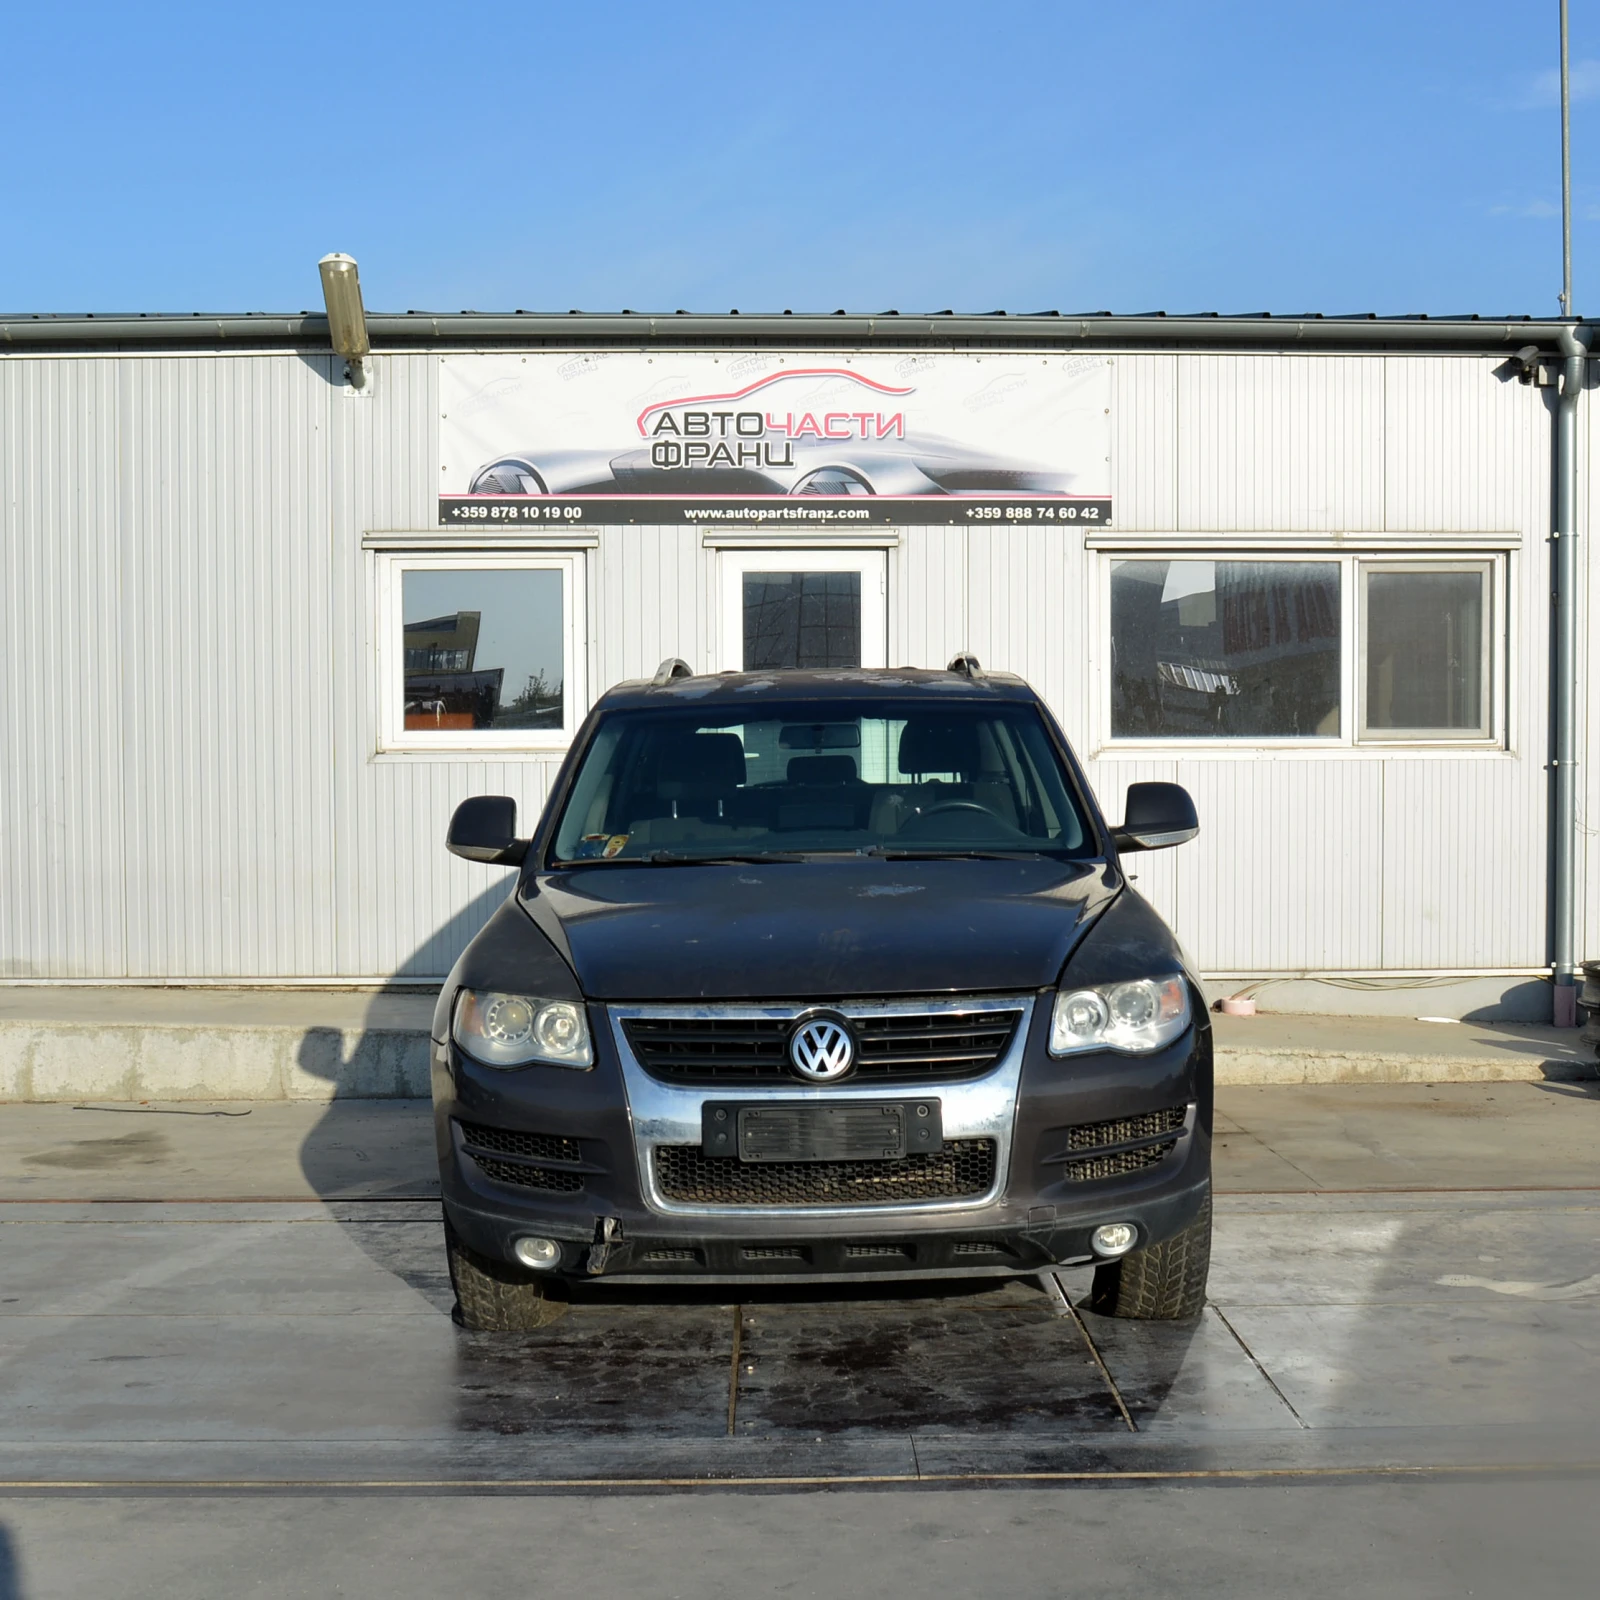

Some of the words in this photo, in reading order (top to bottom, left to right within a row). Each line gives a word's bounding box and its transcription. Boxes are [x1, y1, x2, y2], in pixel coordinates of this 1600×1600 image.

[652, 412, 903, 437] АВТОЧАСТИ
[651, 440, 794, 470] ФРАНЦ
[451, 506, 488, 519] +359
[491, 506, 518, 519] 878
[522, 506, 540, 519] 10
[542, 506, 561, 519] 19
[563, 506, 582, 519] 00
[683, 507, 870, 521] www.autopartsfranz.com
[966, 506, 1002, 519] +359
[1005, 506, 1033, 519] 888
[1036, 506, 1055, 519] 74
[1058, 506, 1077, 519] 60
[1080, 506, 1099, 519] 42
